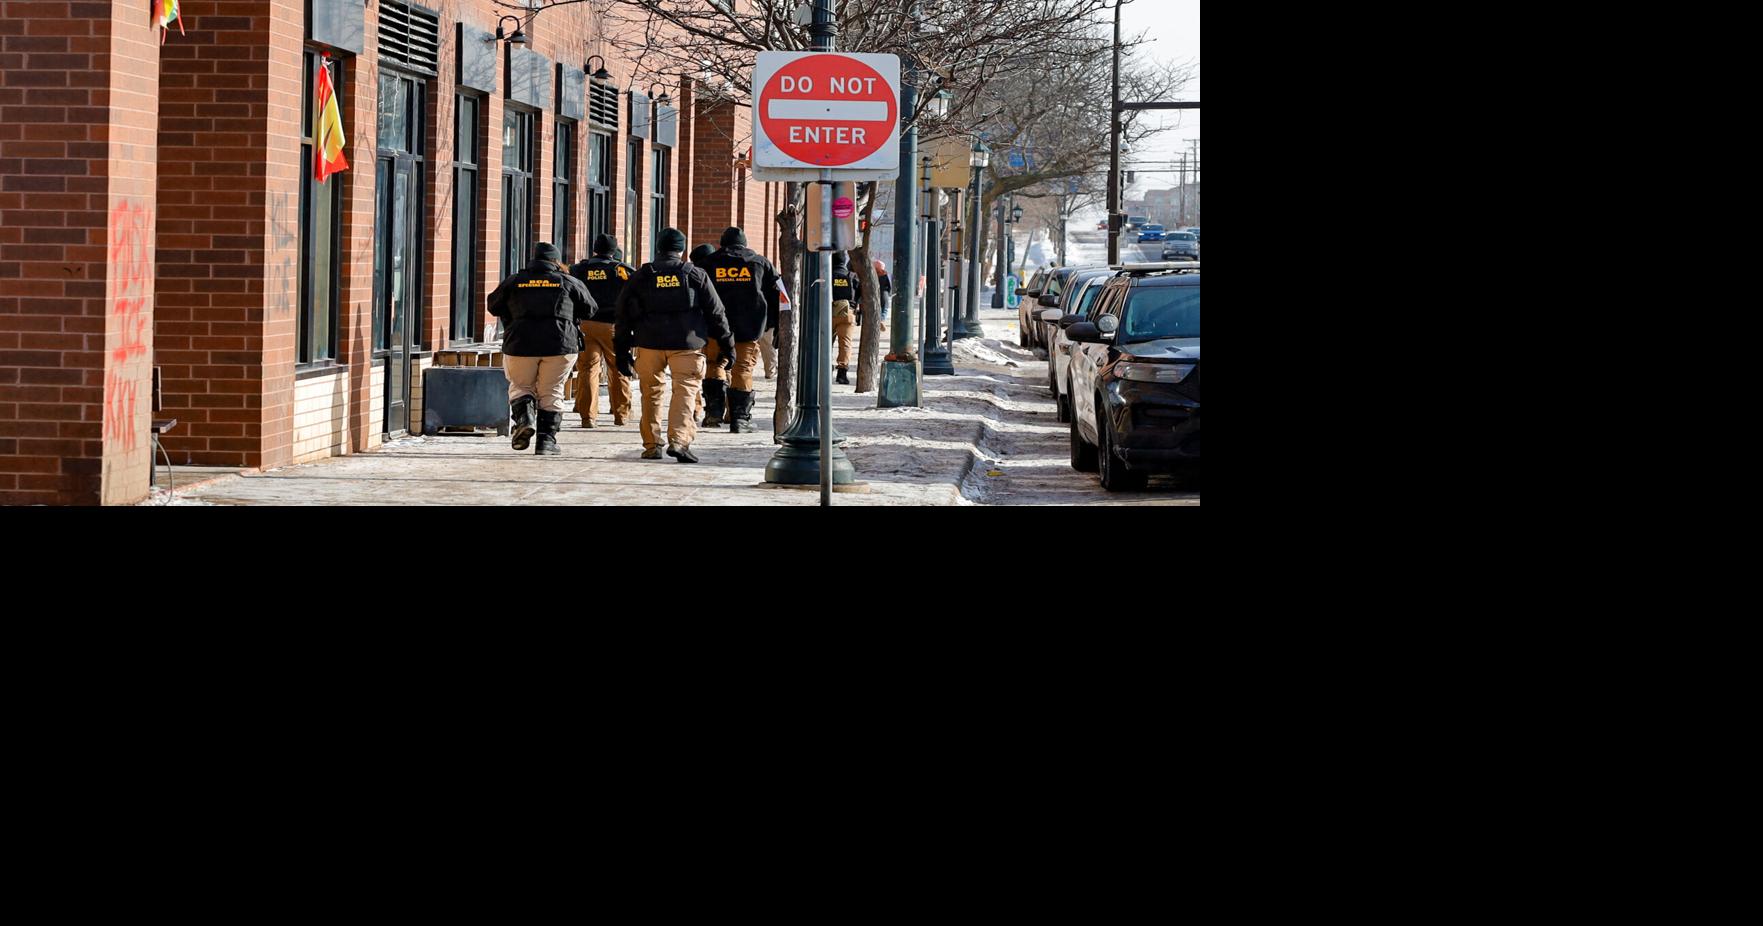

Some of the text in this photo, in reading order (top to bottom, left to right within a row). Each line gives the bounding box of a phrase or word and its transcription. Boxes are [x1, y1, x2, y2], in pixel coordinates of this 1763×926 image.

[780, 75, 877, 94] DO NOT
[789, 126, 866, 144] ENTER
[656, 275, 679, 283] BCA
[716, 267, 751, 278] BCA
